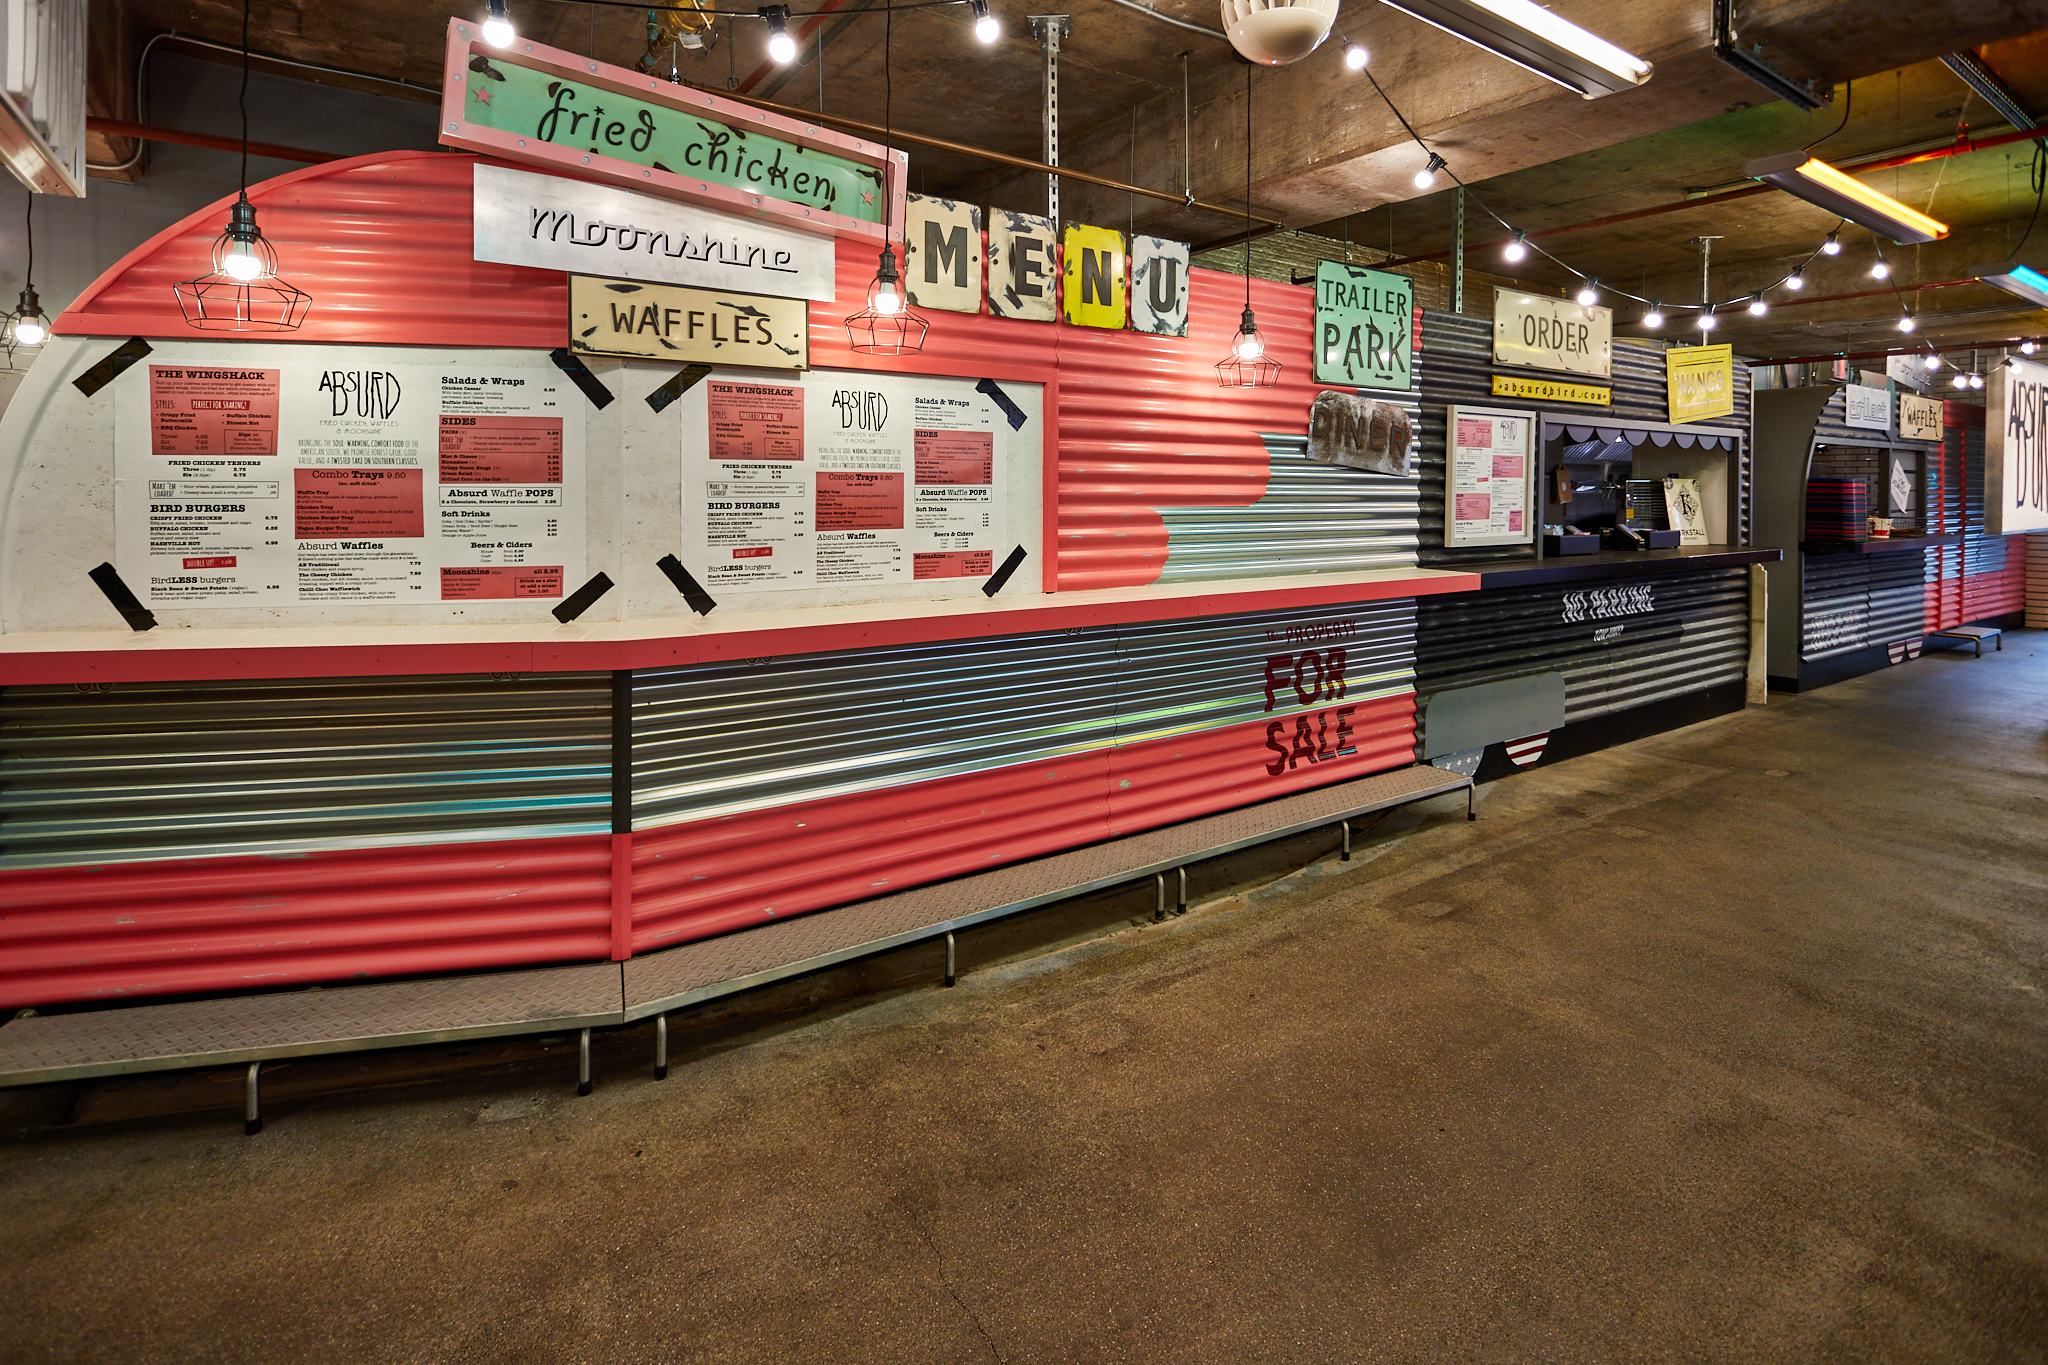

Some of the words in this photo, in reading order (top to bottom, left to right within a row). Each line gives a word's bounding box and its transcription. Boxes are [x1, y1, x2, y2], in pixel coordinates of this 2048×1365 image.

[537, 88, 656, 151] fried
[685, 132, 830, 200] chicken
[925, 220, 1176, 313] MENU
[1322, 279, 1407, 316] TRAILER
[611, 302, 772, 345] WAFFLES
[1524, 314, 1589, 354] ORDER
[1324, 322, 1406, 372] PARK
[156, 370, 183, 378] THE
[186, 370, 265, 380] WINGSHACK
[442, 376, 477, 384] Salads
[491, 377, 525, 386] Wraps
[1676, 370, 1724, 396] WINGS
[319, 371, 401, 419] ABSURD
[735, 386, 793, 396] WINGSHACK
[948, 399, 969, 407] Wraps
[155, 400, 176, 409] STYLES:
[193, 400, 212, 409] PERFECT
[213, 401, 222, 409] FOR
[222, 401, 246, 409] SHARING!
[832, 390, 888, 431] ABSURD
[1907, 404, 1937, 428] WAFFLES
[442, 418, 476, 426] SIDES
[1312, 408, 1405, 456] DINER
[312, 470, 348, 479] Combo
[351, 471, 384, 480] Trays
[856, 474, 878, 482] Trays
[298, 542, 337, 550] Absurd
[340, 542, 384, 550] Waffles
[187, 559, 205, 567] DOUBLE
[200, 576, 236, 584] burgers
[1562, 592, 1587, 623] NO
[1590, 585, 1655, 619] PARKING
[1286, 620, 1357, 644] PROPERTY
[1265, 648, 1347, 712] FOR
[1266, 705, 1358, 776] SALE
